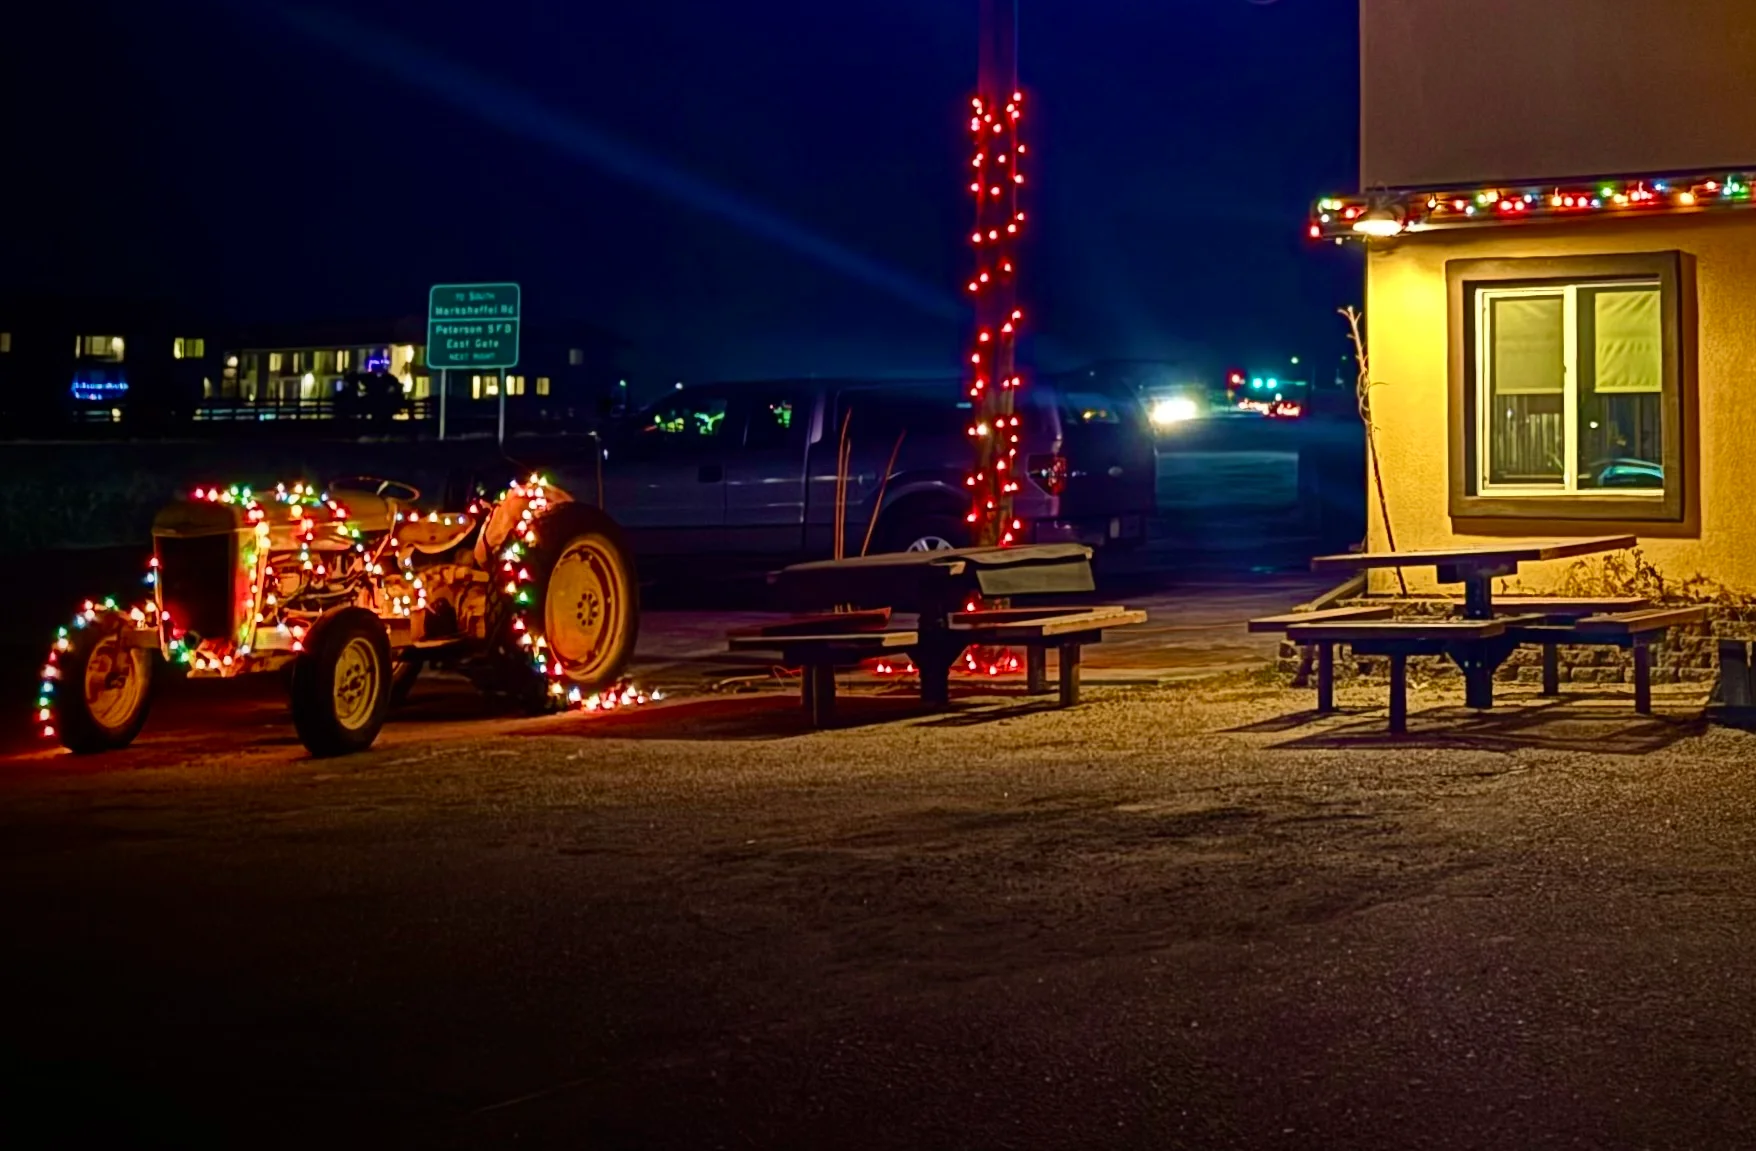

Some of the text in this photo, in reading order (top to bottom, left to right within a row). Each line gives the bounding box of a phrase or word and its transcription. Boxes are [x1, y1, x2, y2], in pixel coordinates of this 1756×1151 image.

[436, 325, 482, 334] Peterson
[446, 338, 499, 349] East Gate
